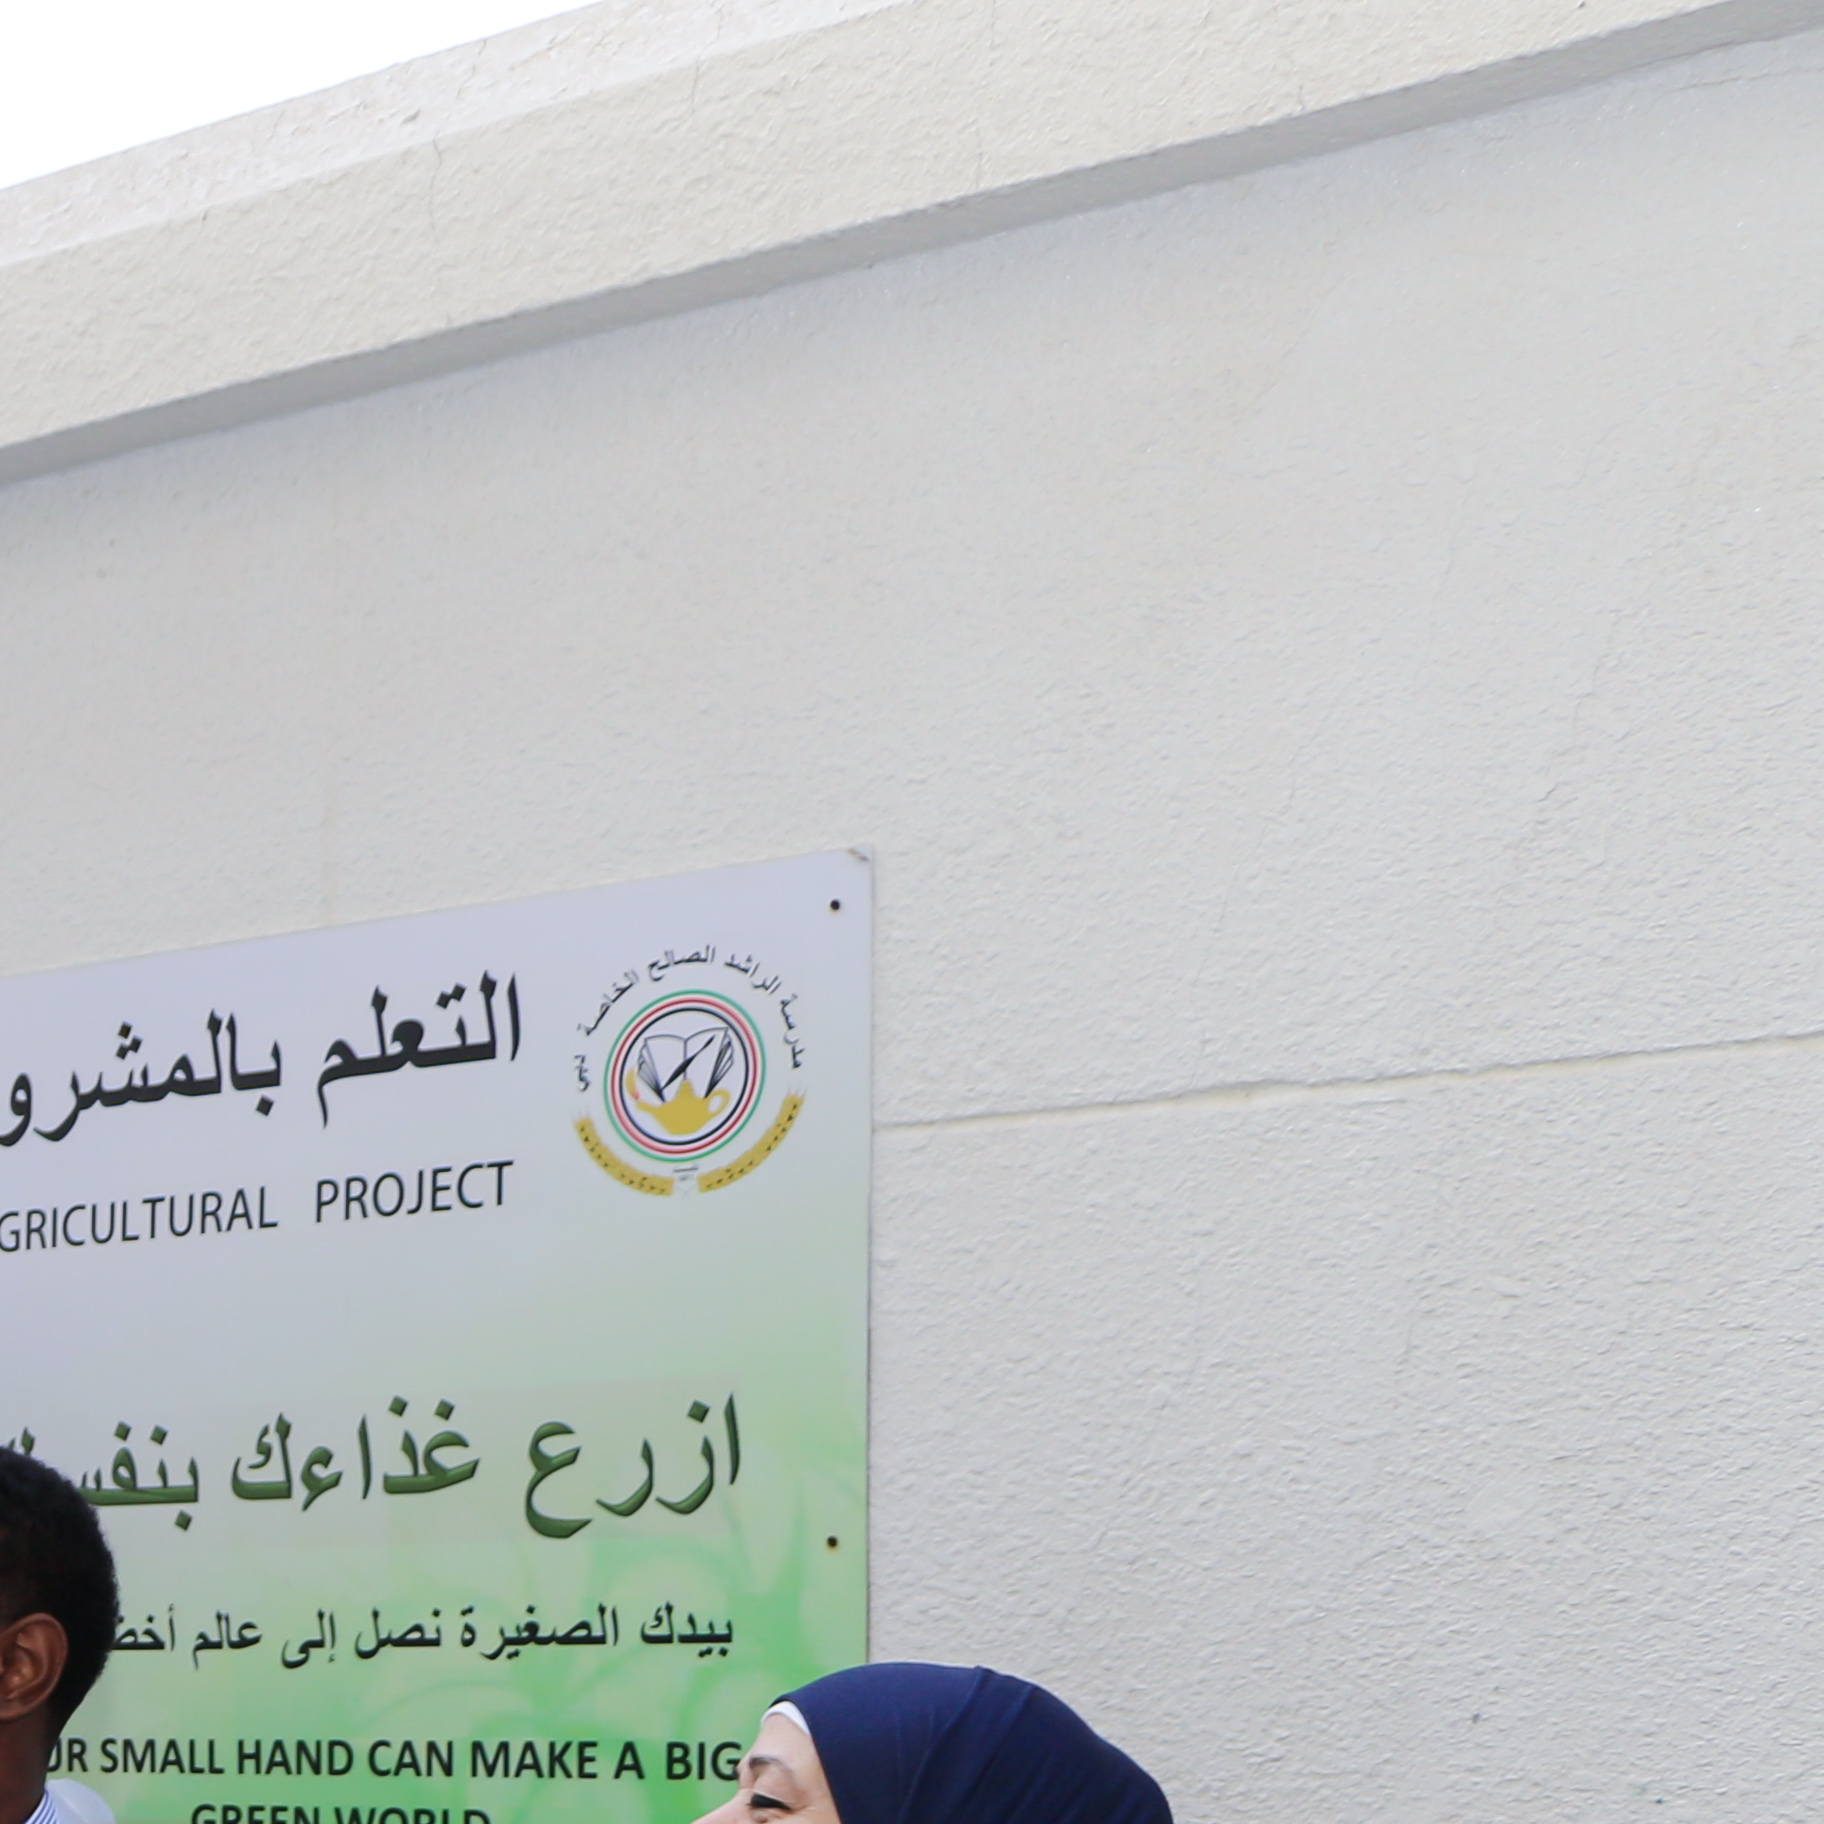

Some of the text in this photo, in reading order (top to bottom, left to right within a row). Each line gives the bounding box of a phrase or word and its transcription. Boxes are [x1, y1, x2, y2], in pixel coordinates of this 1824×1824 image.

[316, 970, 521, 1128] التعلم
[315, 1160, 514, 1224] PROJECT
[7, 1393, 741, 1540] ازرع غذاءك بنفس
[112, 1602, 734, 1671] بيدك الصغيرة نصل إلى عالم أخض
[46, 1737, 742, 1781] UR SMALL HAND CAN MAKE A BIG
